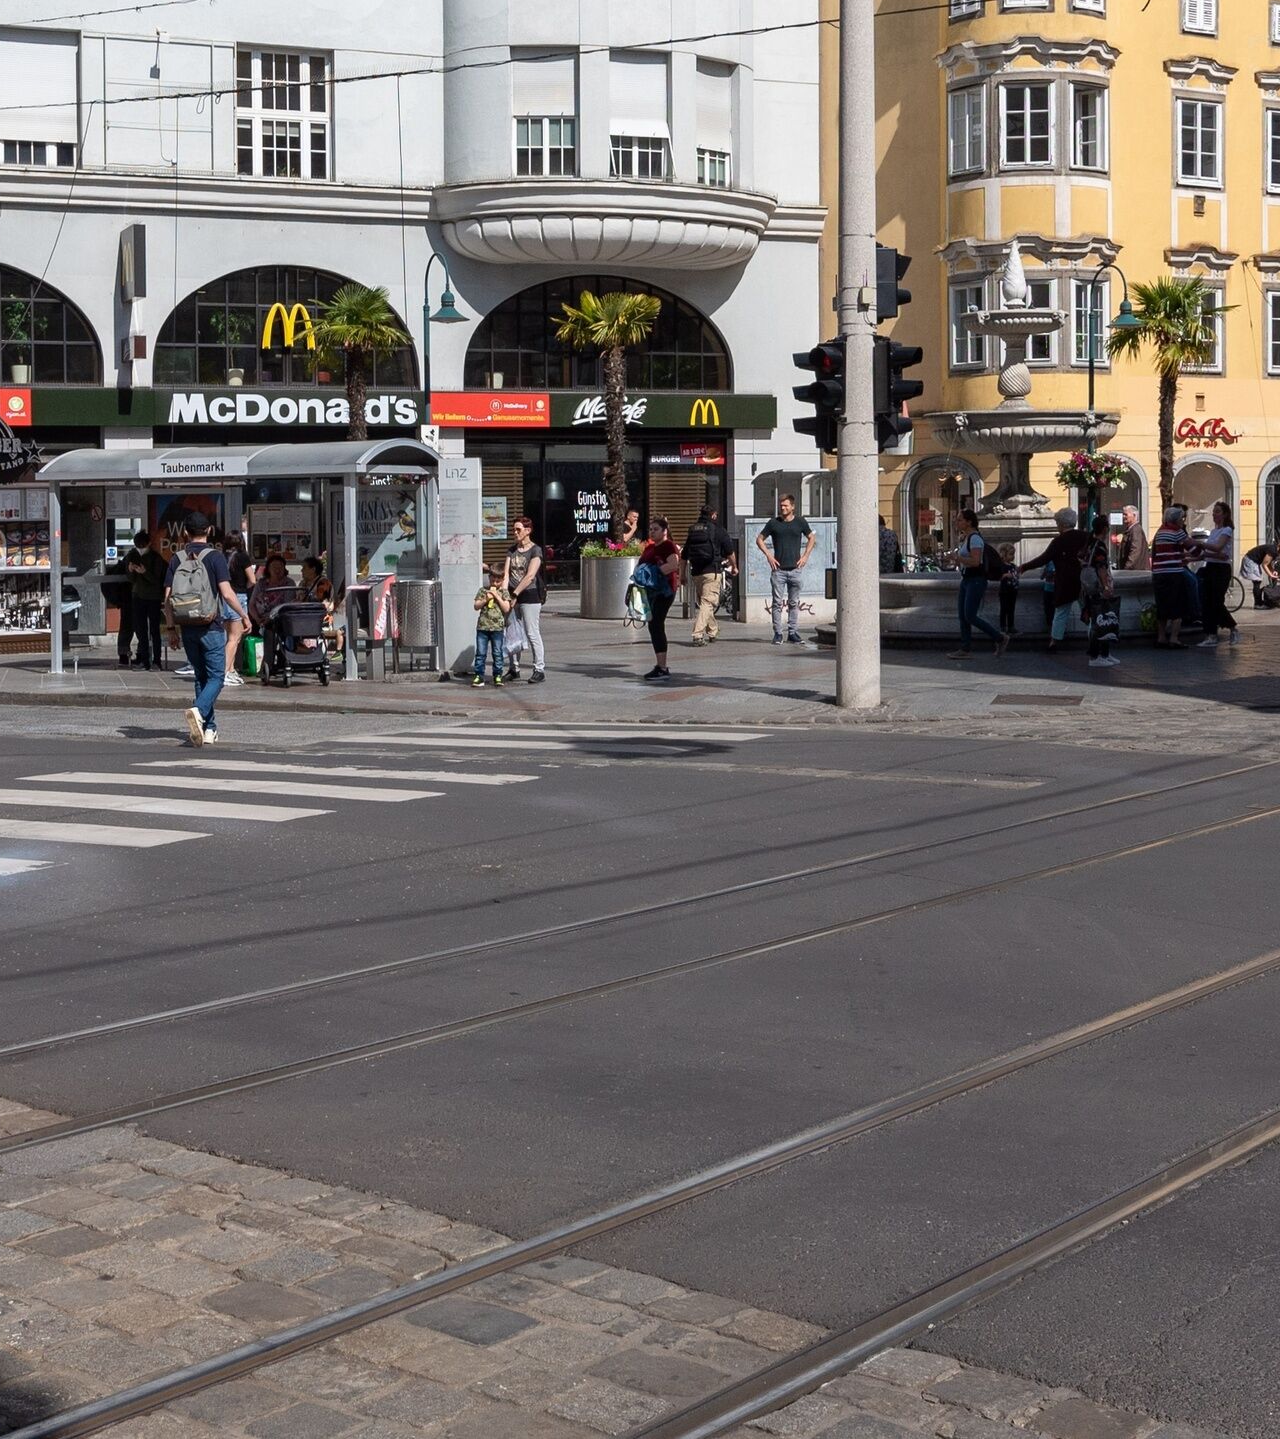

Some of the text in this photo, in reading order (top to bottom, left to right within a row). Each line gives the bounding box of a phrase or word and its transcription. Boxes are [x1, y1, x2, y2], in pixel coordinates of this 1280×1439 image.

[168, 393, 418, 425] McDonad's
[161, 462, 224, 473] Taubenmarkt
[578, 490, 608, 508] Günstig,
[574, 509, 610, 521] weil du uns
[576, 521, 595, 533] teuer
